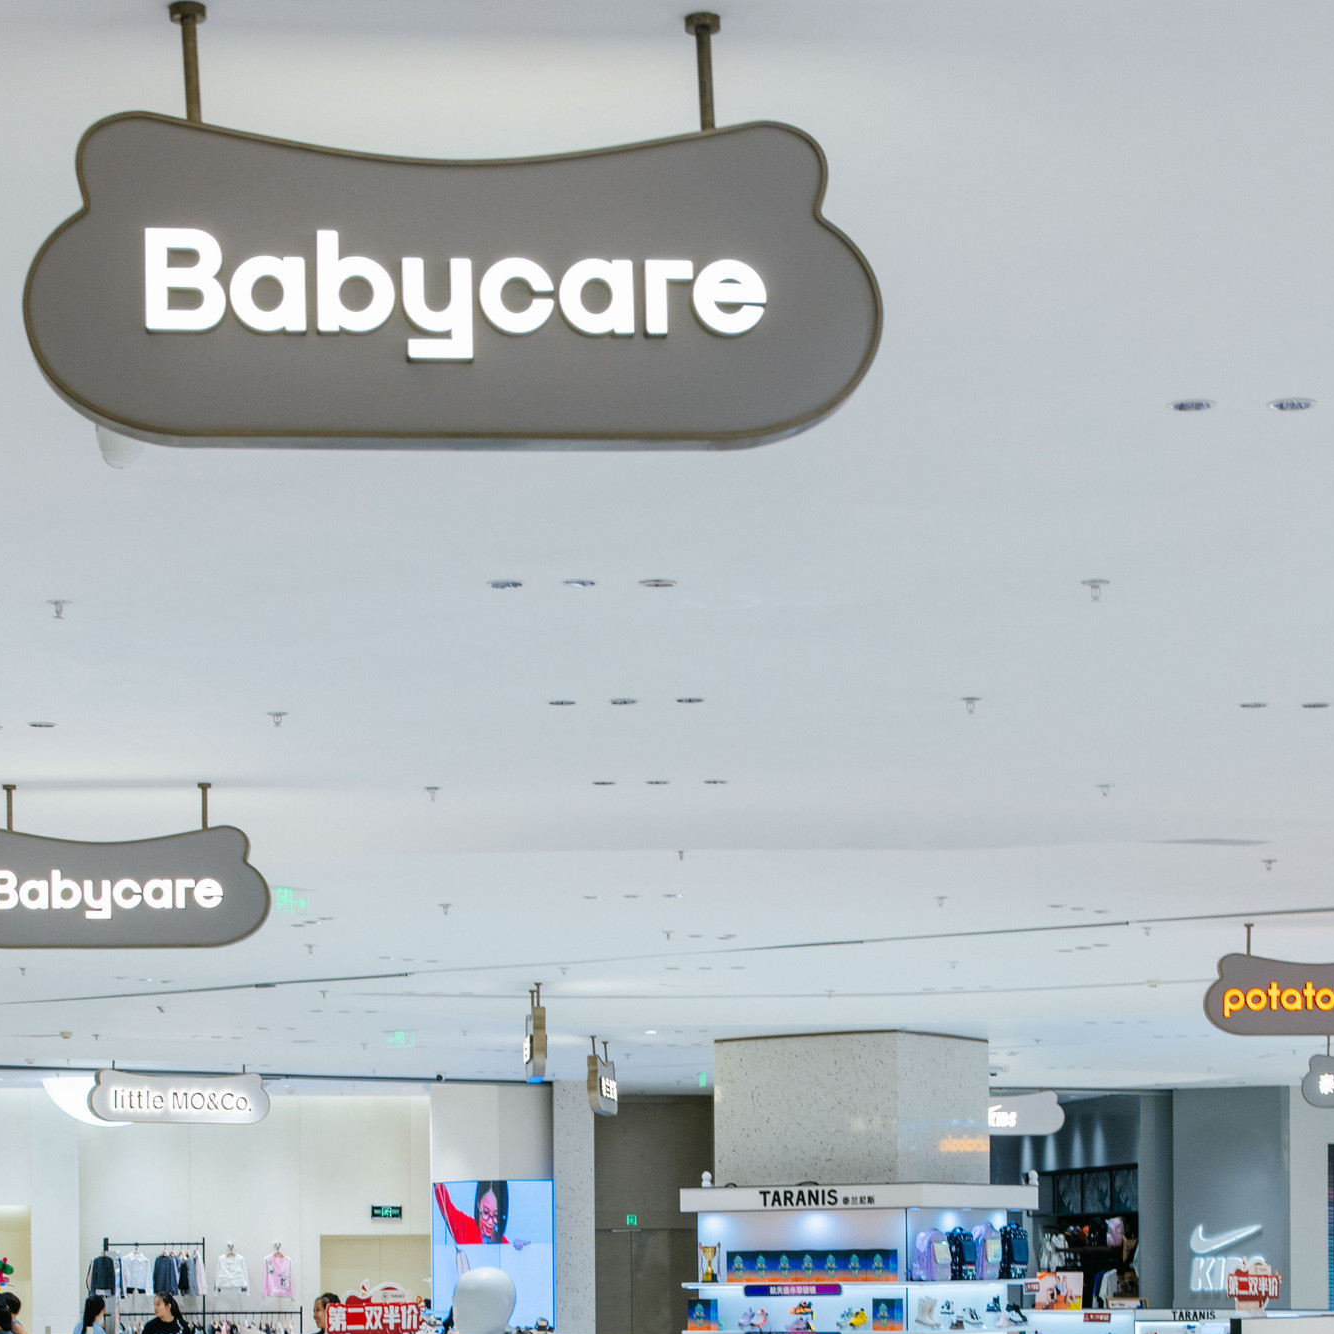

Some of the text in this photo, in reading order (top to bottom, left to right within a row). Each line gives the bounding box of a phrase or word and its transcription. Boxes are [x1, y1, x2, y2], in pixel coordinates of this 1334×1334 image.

[144, 226, 769, 361] Babycare
[113, 1089, 253, 1112] little MO&Co.
[759, 1189, 876, 1207] TARANIS 泰兰尼斯
[1228, 1276, 1279, 1297] 第二双半价
[328, 1304, 419, 1332] 第二双半价
[1171, 1310, 1216, 1322] TARANIS
